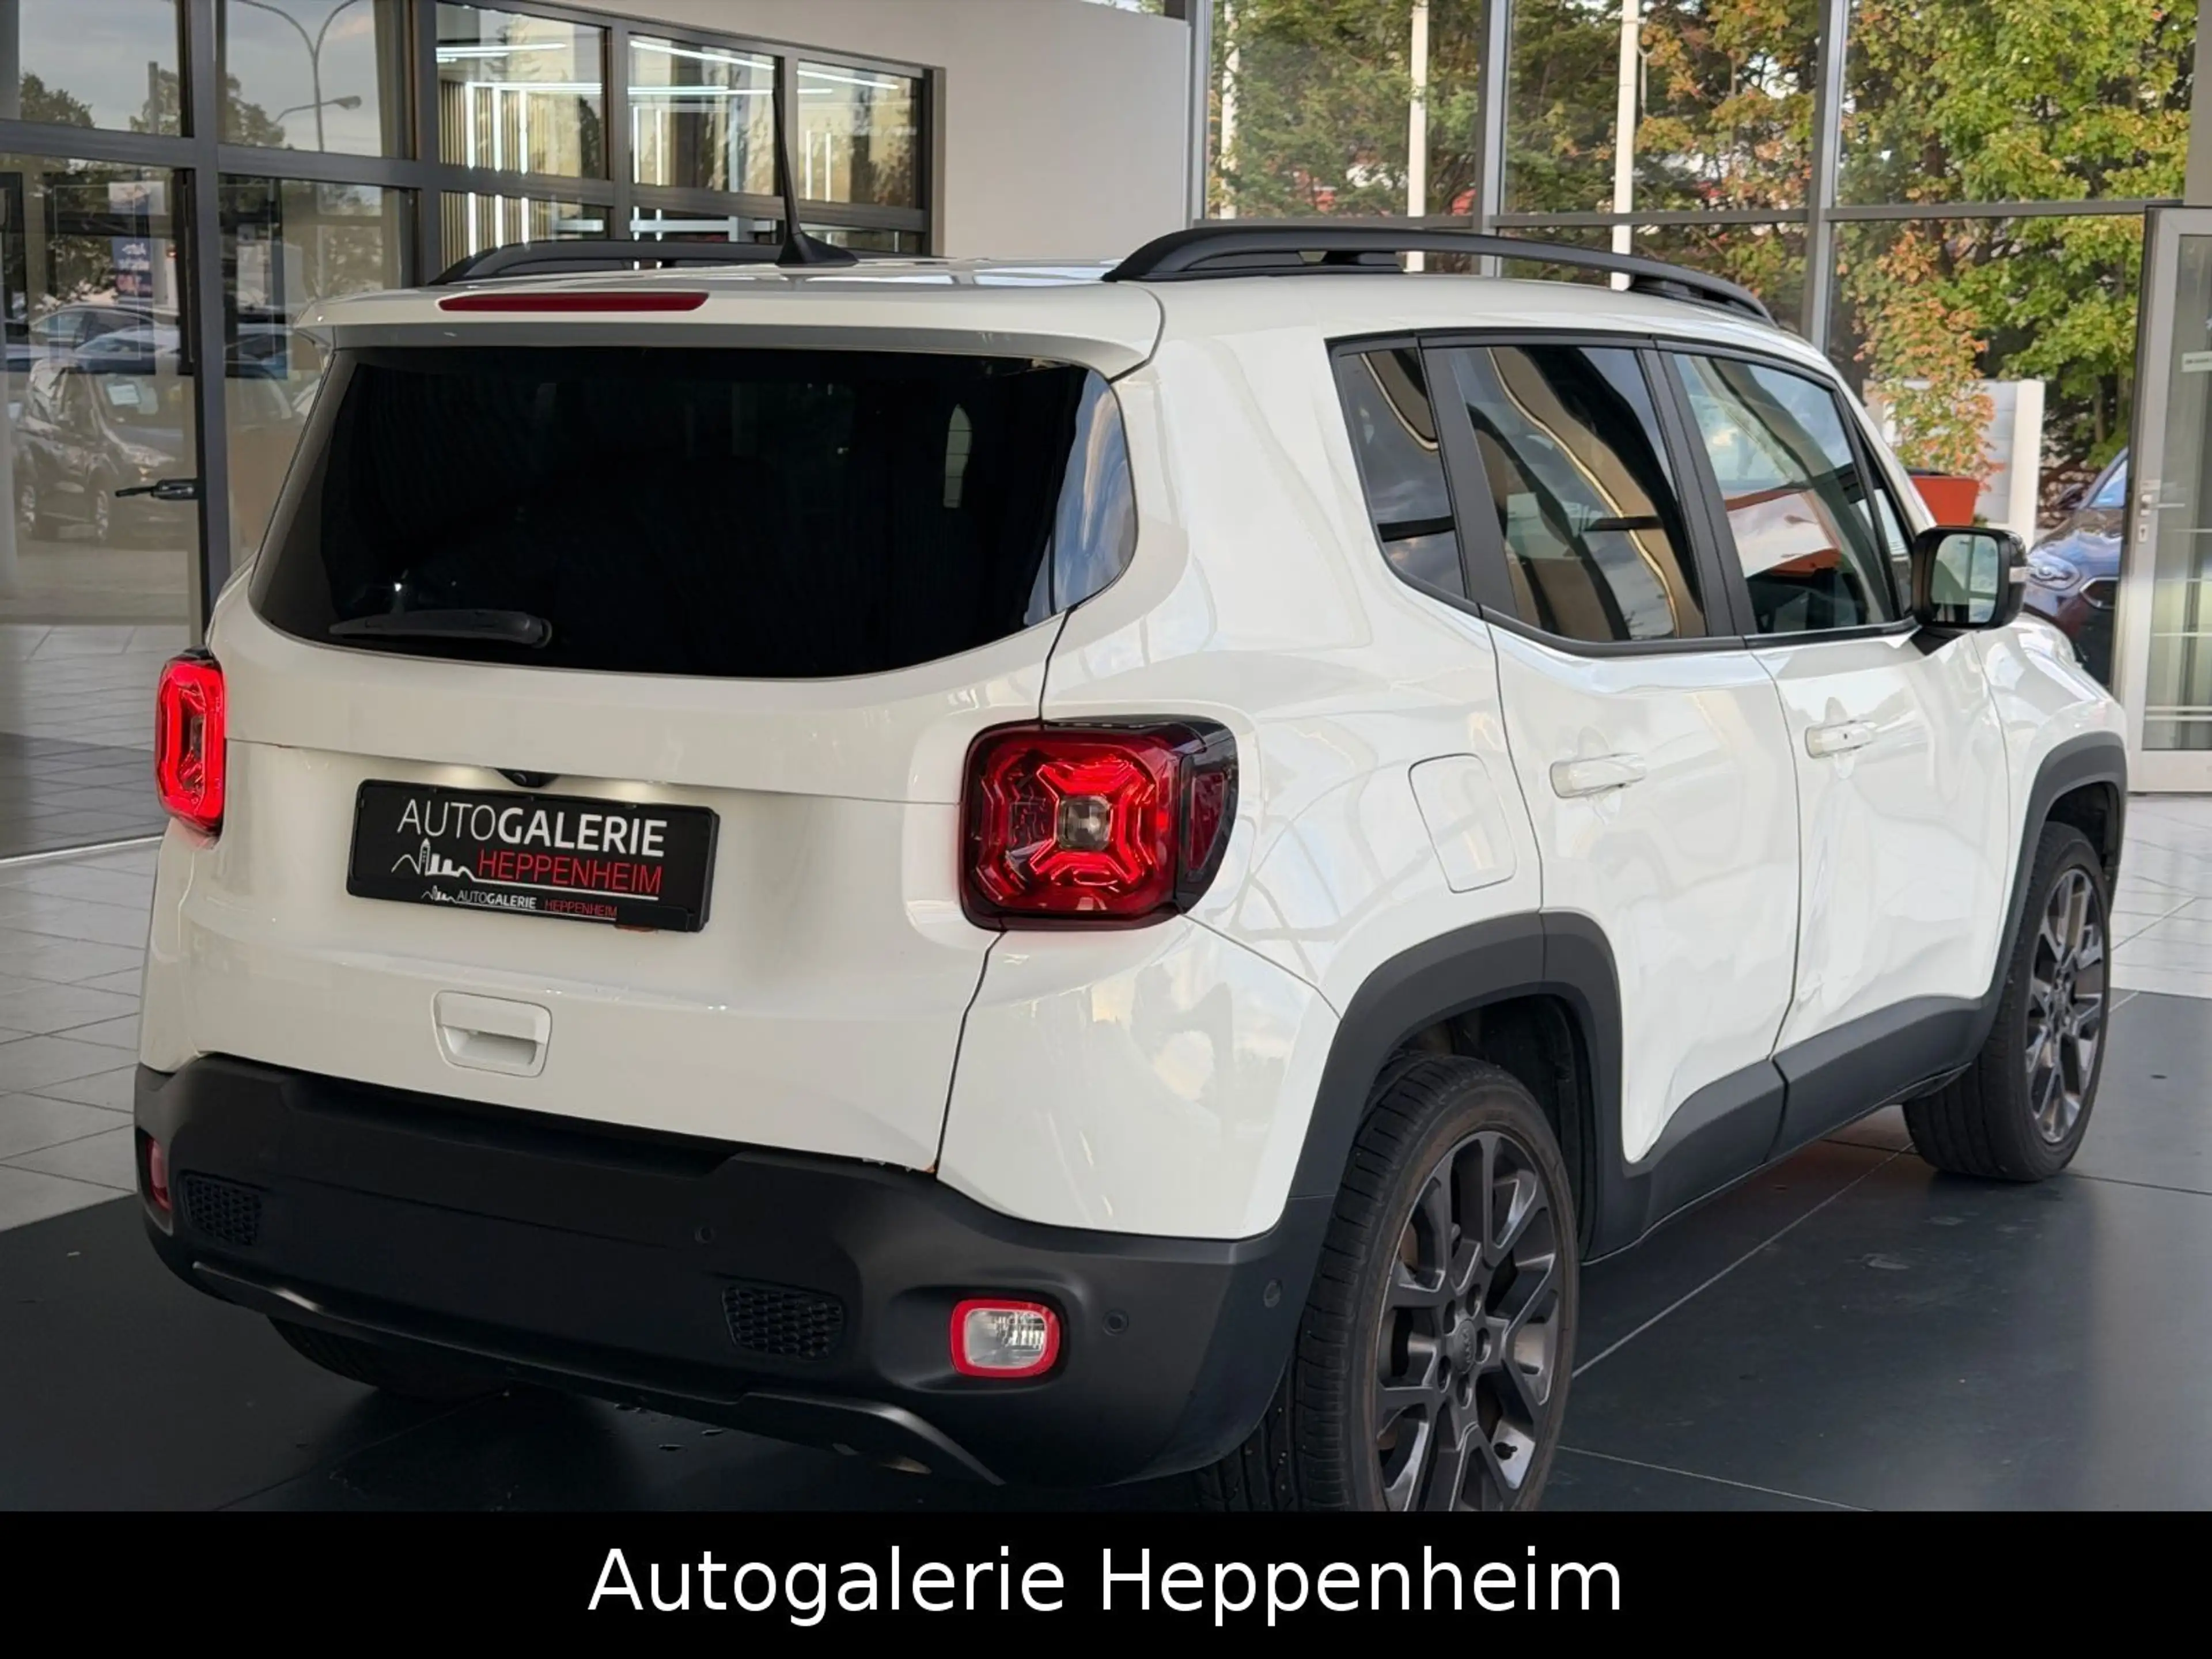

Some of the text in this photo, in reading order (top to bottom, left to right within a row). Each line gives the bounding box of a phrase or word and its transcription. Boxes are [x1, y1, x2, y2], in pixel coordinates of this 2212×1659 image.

[397, 799, 668, 857] AUTOGALERIE
[478, 849, 662, 894] HEPPENHEIM
[456, 890, 618, 918] AUTOGALERIE HEPPENHEIM
